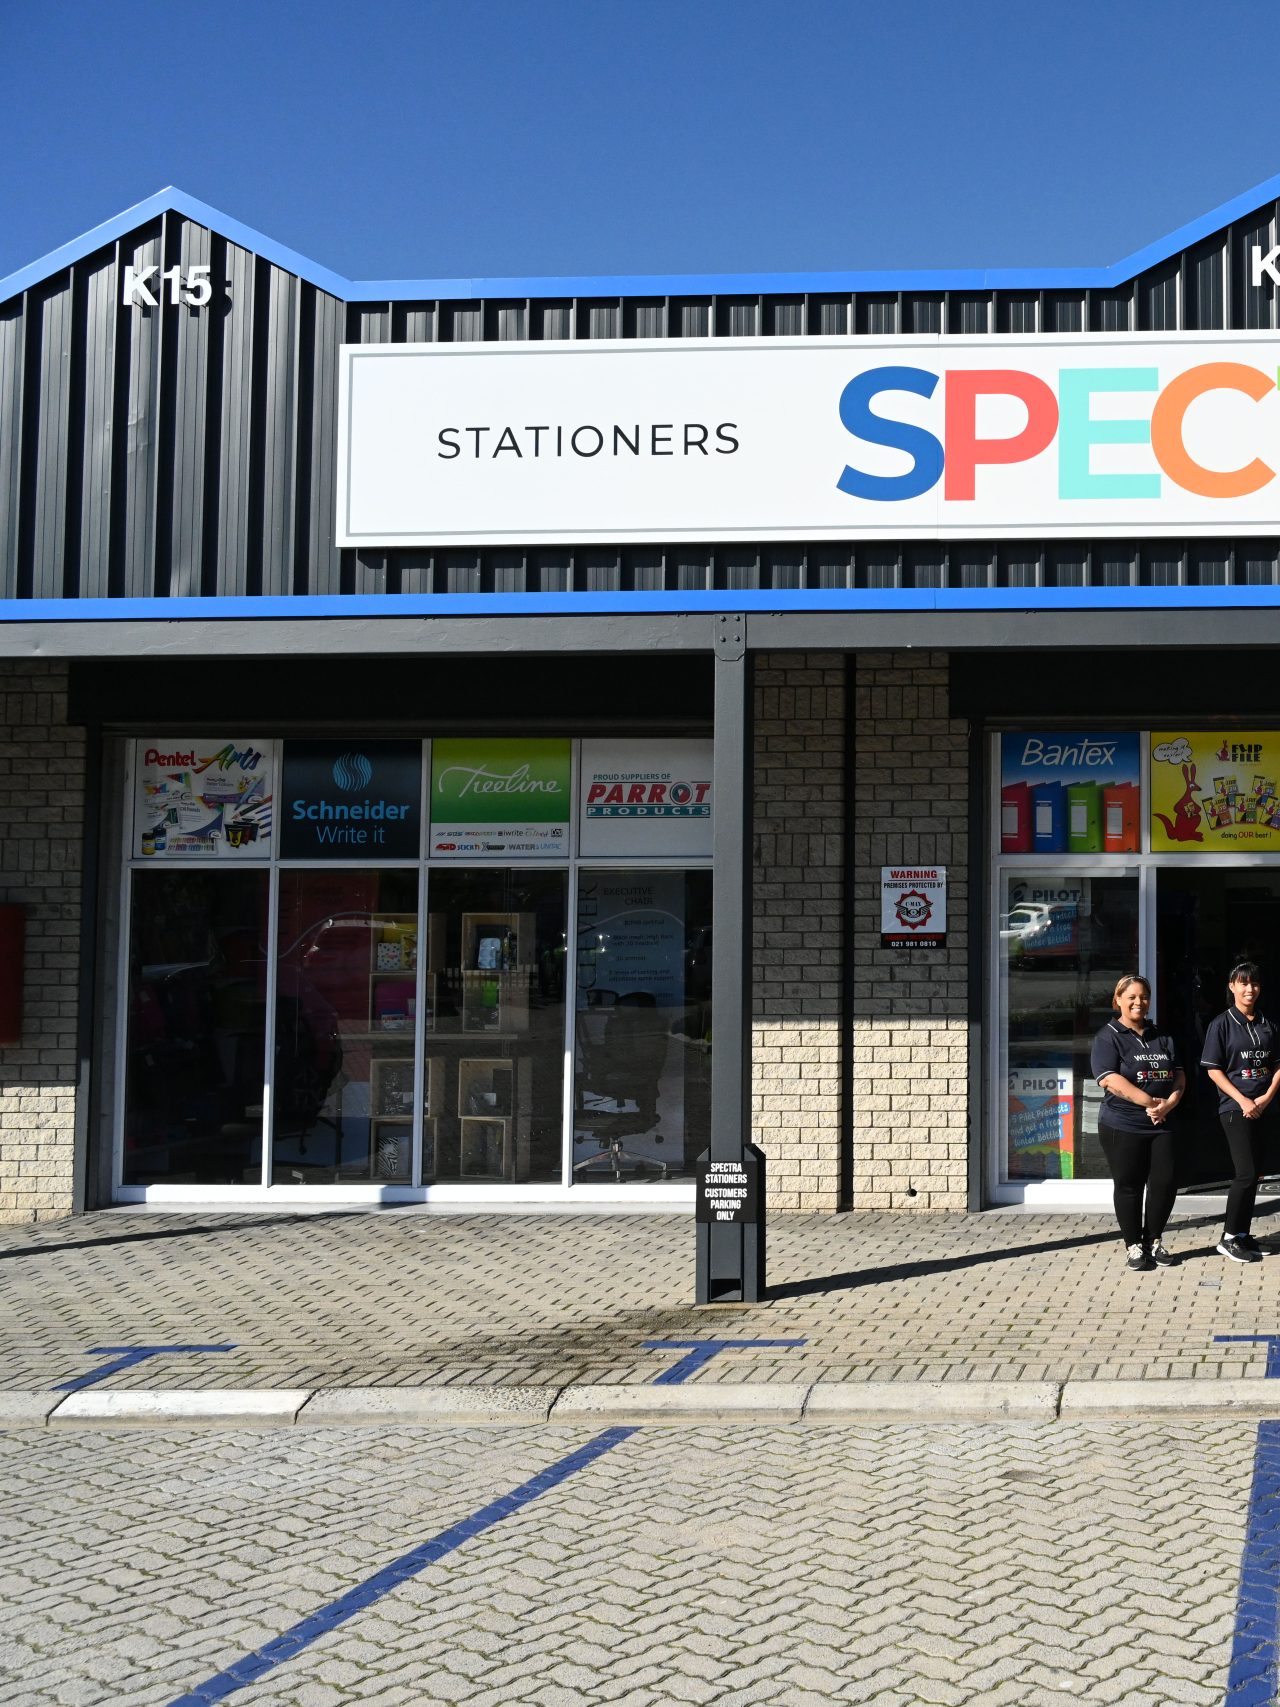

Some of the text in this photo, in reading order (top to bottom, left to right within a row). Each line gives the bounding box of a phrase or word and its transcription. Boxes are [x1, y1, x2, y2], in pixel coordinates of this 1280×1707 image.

[122, 264, 213, 306] K15
[437, 422, 741, 459] STATIONERS
[144, 748, 197, 767] Pentel
[1021, 738, 1118, 766] Bantex
[192, 743, 262, 774] Arts
[1231, 753, 1261, 763] FILE
[438, 763, 563, 798] Treeline
[586, 782, 712, 805] PARROT
[292, 799, 411, 821] Schneider
[587, 807, 710, 816] PRODUCTS
[315, 824, 386, 845] Write it
[1220, 832, 1238, 840] doing
[890, 870, 938, 879] WARNING
[603, 887, 655, 896] EXECUTIVE
[1032, 889, 1080, 902] PILOT
[1149, 1061, 1159, 1069] TO
[1136, 1070, 1174, 1080] SPECTRA
[1022, 1079, 1067, 1091] PILOT
[710, 1162, 743, 1173] SPECTRA
[705, 1173, 748, 1184] STATIONERS
[704, 1187, 748, 1198] CUSTOMERS
[710, 1199, 742, 1210] PARKING
[716, 1210, 735, 1221] ONLY
